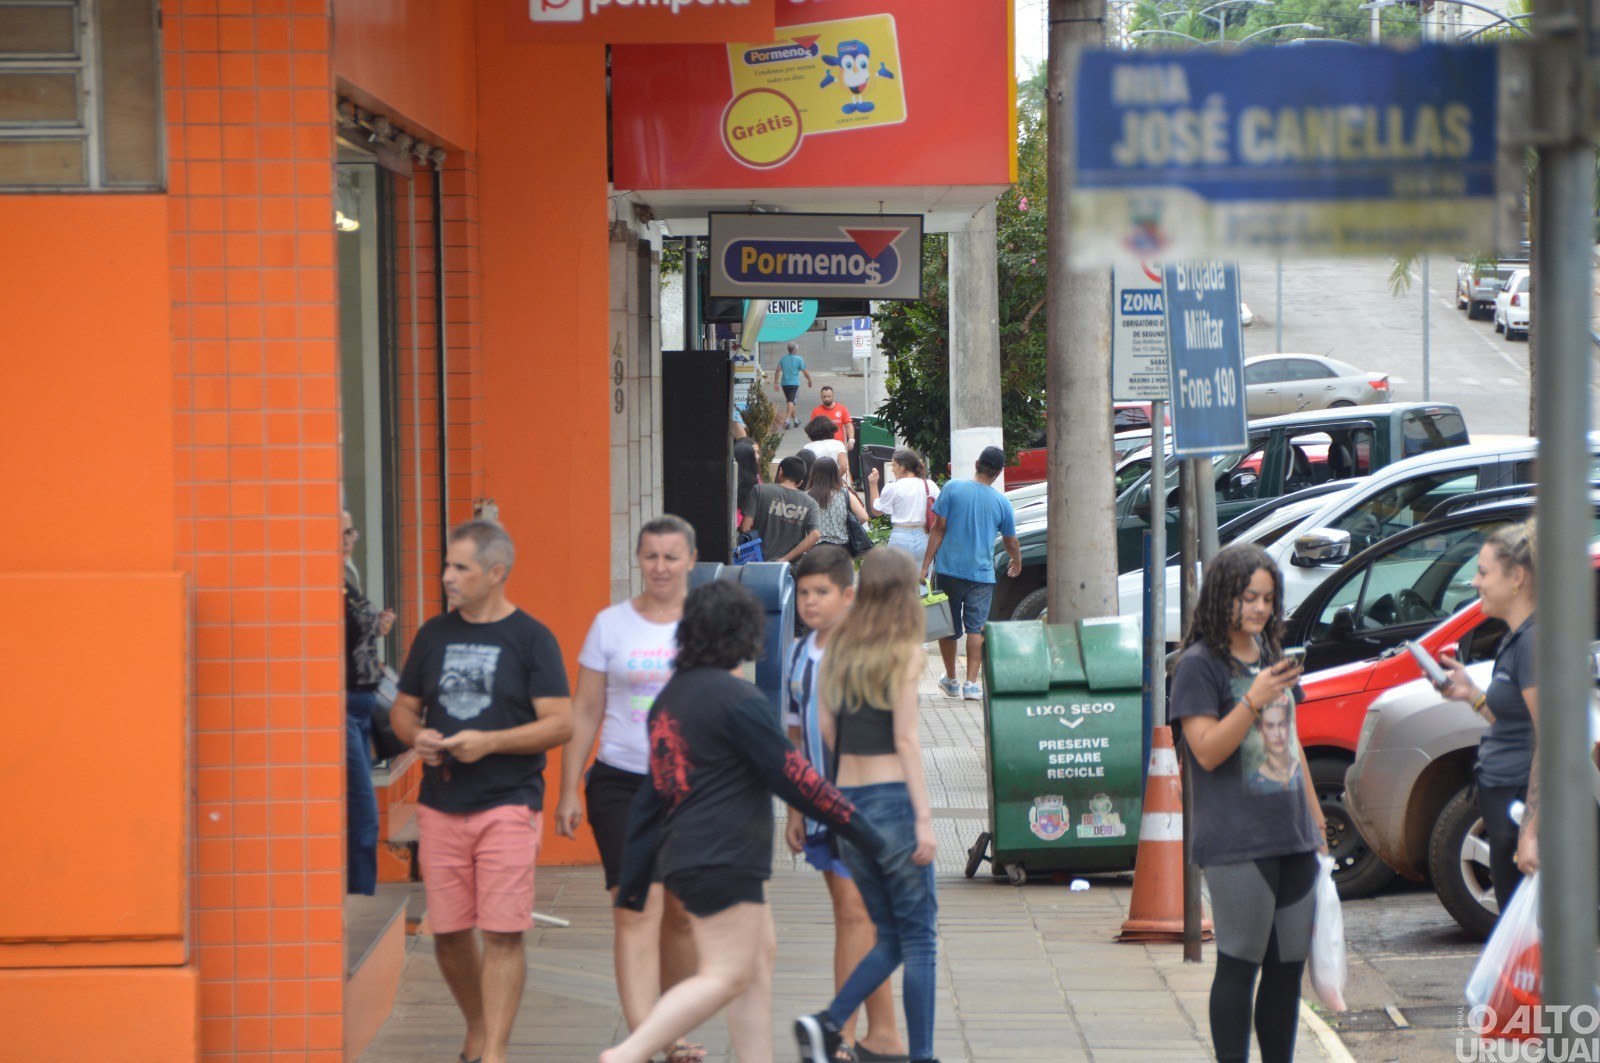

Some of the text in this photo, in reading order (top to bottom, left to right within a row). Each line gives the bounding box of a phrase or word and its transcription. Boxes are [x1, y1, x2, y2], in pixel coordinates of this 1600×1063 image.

[731, 114, 793, 141] Grátis
[1112, 93, 1473, 167] JOSÉ CANELLAS
[1177, 260, 1226, 300] Brigada
[1123, 294, 1163, 311] ZONA
[1122, 319, 1158, 327] OBRIGATÓRIO
[1184, 309, 1224, 350] Militar
[1179, 367, 1236, 409] Fone 190
[769, 500, 809, 520] HIGH
[1027, 702, 1115, 716] LIXO SECO
[1039, 738, 1109, 751] PRESERVE
[1049, 752, 1101, 764] SEPARE
[1047, 766, 1104, 779] RECICLE
